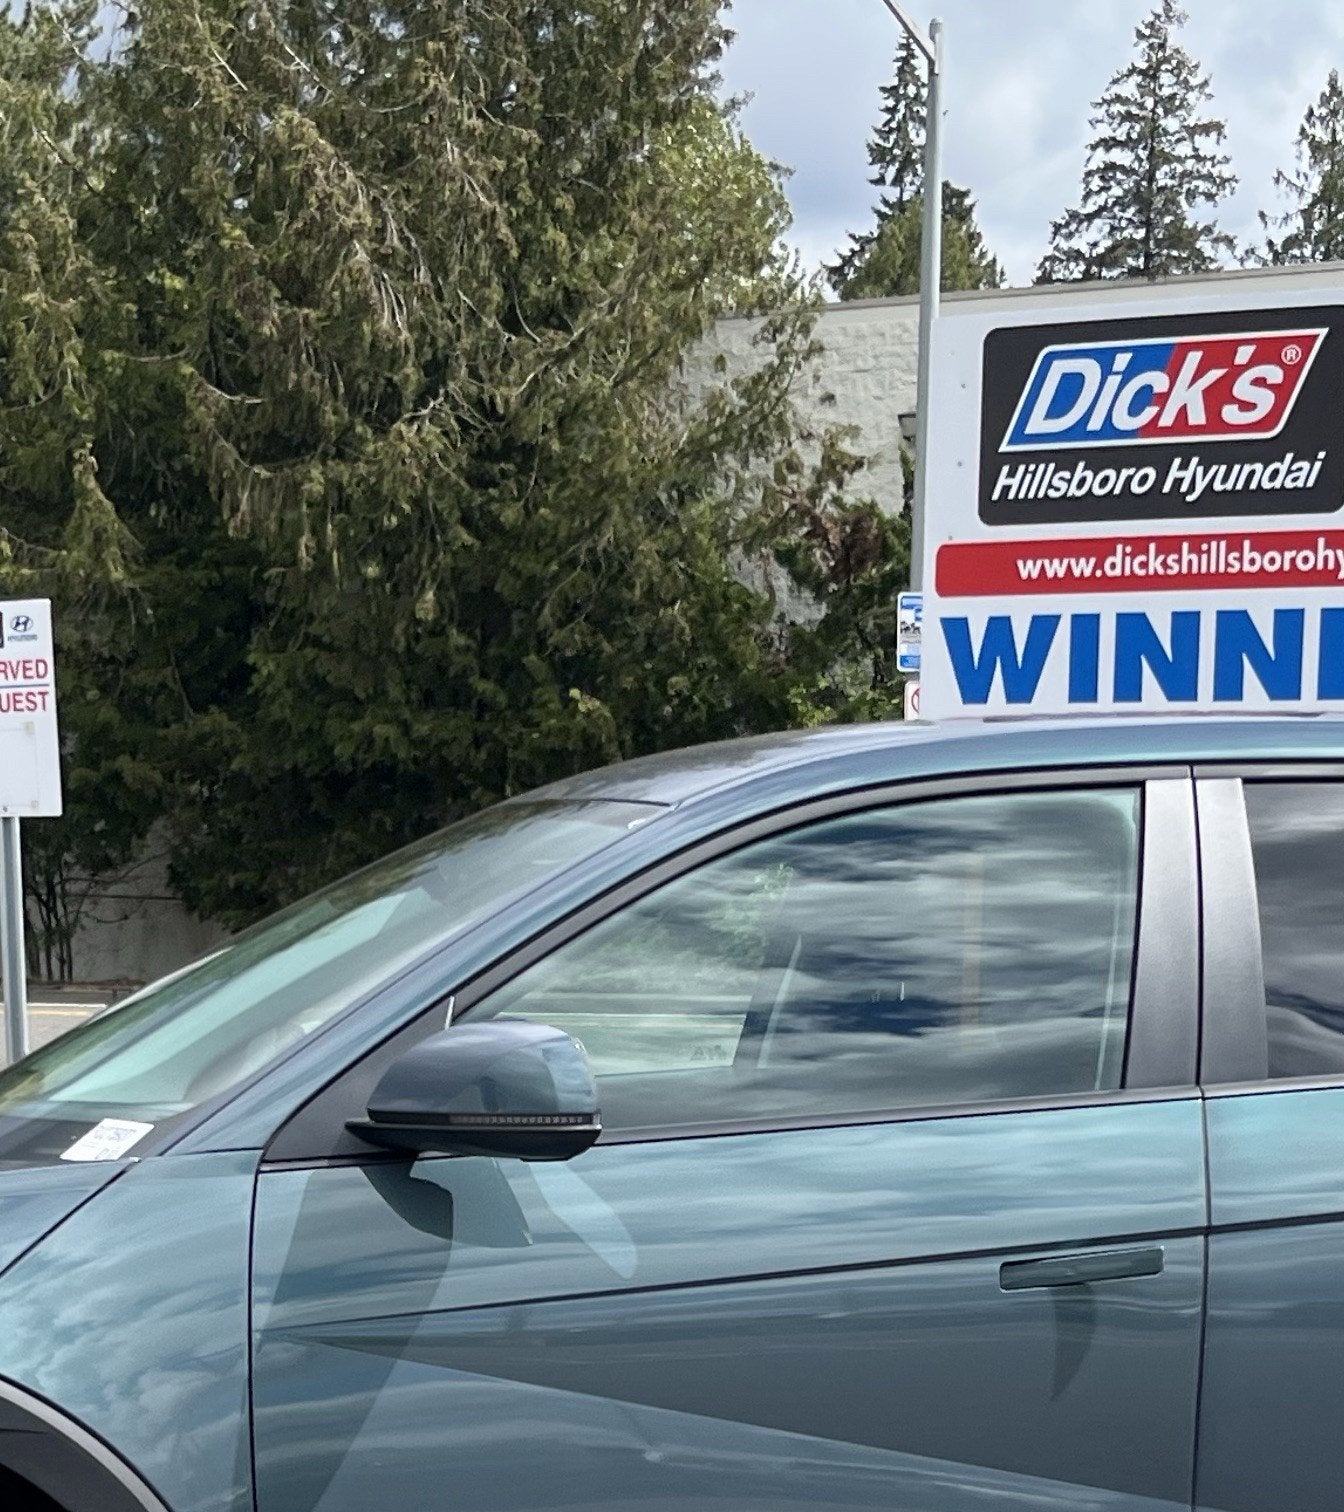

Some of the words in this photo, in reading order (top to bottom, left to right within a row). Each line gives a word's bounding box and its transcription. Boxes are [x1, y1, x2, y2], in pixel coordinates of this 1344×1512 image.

[1023, 345, 1285, 435] Dick's
[991, 459, 1157, 502] Hillsboro
[1162, 451, 1327, 502] Hyundai
